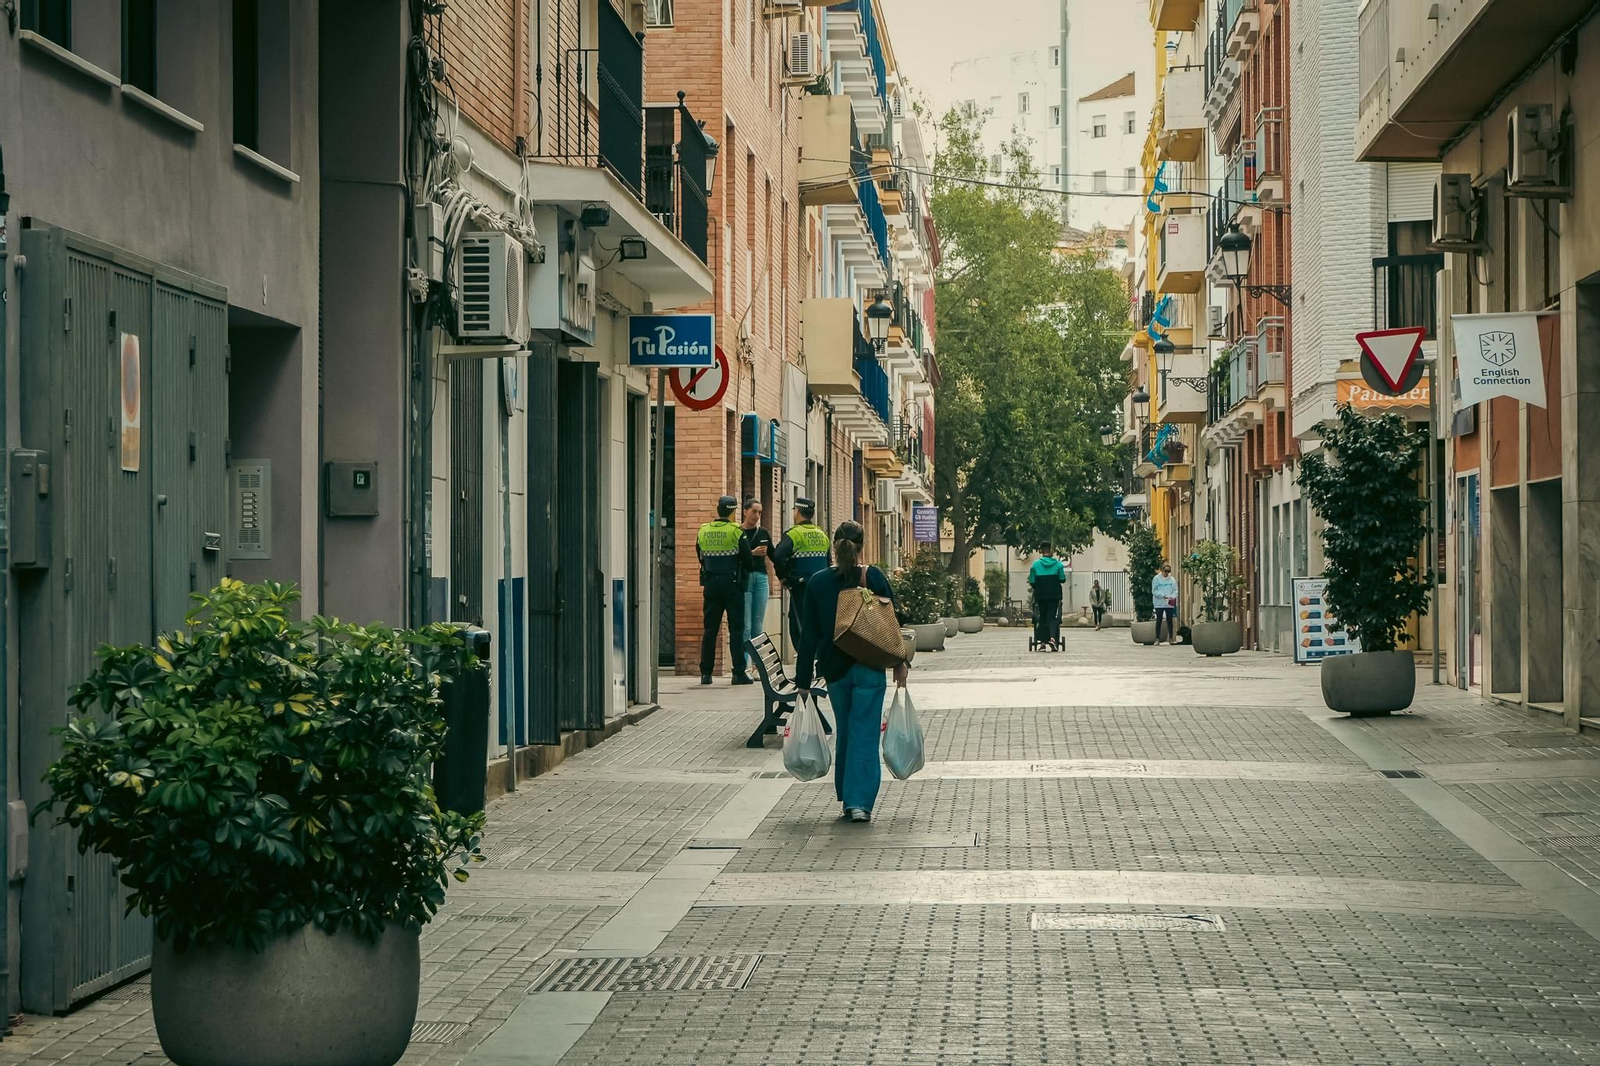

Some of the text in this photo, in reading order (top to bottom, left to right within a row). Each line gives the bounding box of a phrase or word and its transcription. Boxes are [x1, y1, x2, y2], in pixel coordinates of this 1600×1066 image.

[632, 325, 709, 356] Tu Pasión
[1481, 368, 1520, 378] English
[1473, 376, 1531, 385] Connection
[703, 531, 727, 539] POLICIA
